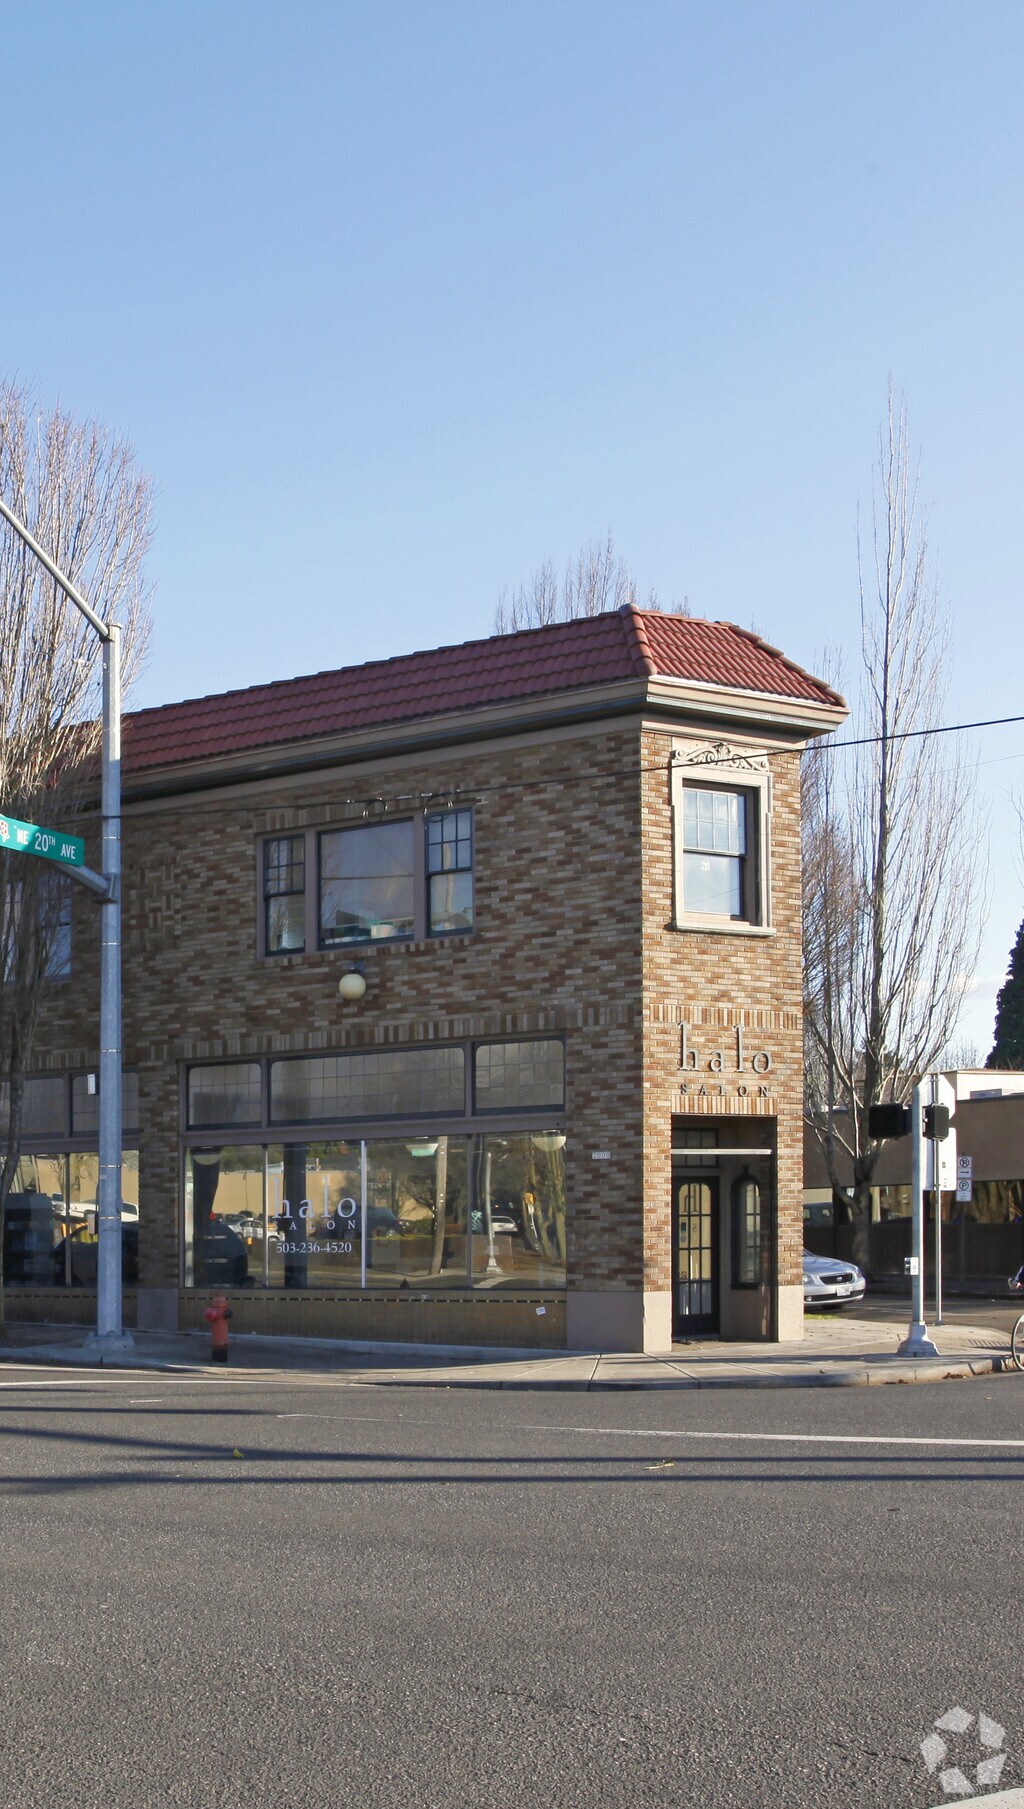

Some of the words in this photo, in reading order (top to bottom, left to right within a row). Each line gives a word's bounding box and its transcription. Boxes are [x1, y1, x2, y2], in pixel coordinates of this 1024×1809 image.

[17, 829, 29, 845] NE
[34, 833, 56, 852] 20TH
[60, 844, 76, 859] AVE
[677, 1020, 773, 1074] halo
[680, 1083, 770, 1097] SALON
[272, 1174, 356, 1219] halo
[272, 1220, 356, 1231] SALON
[276, 1241, 352, 1254] 503-236-4520
